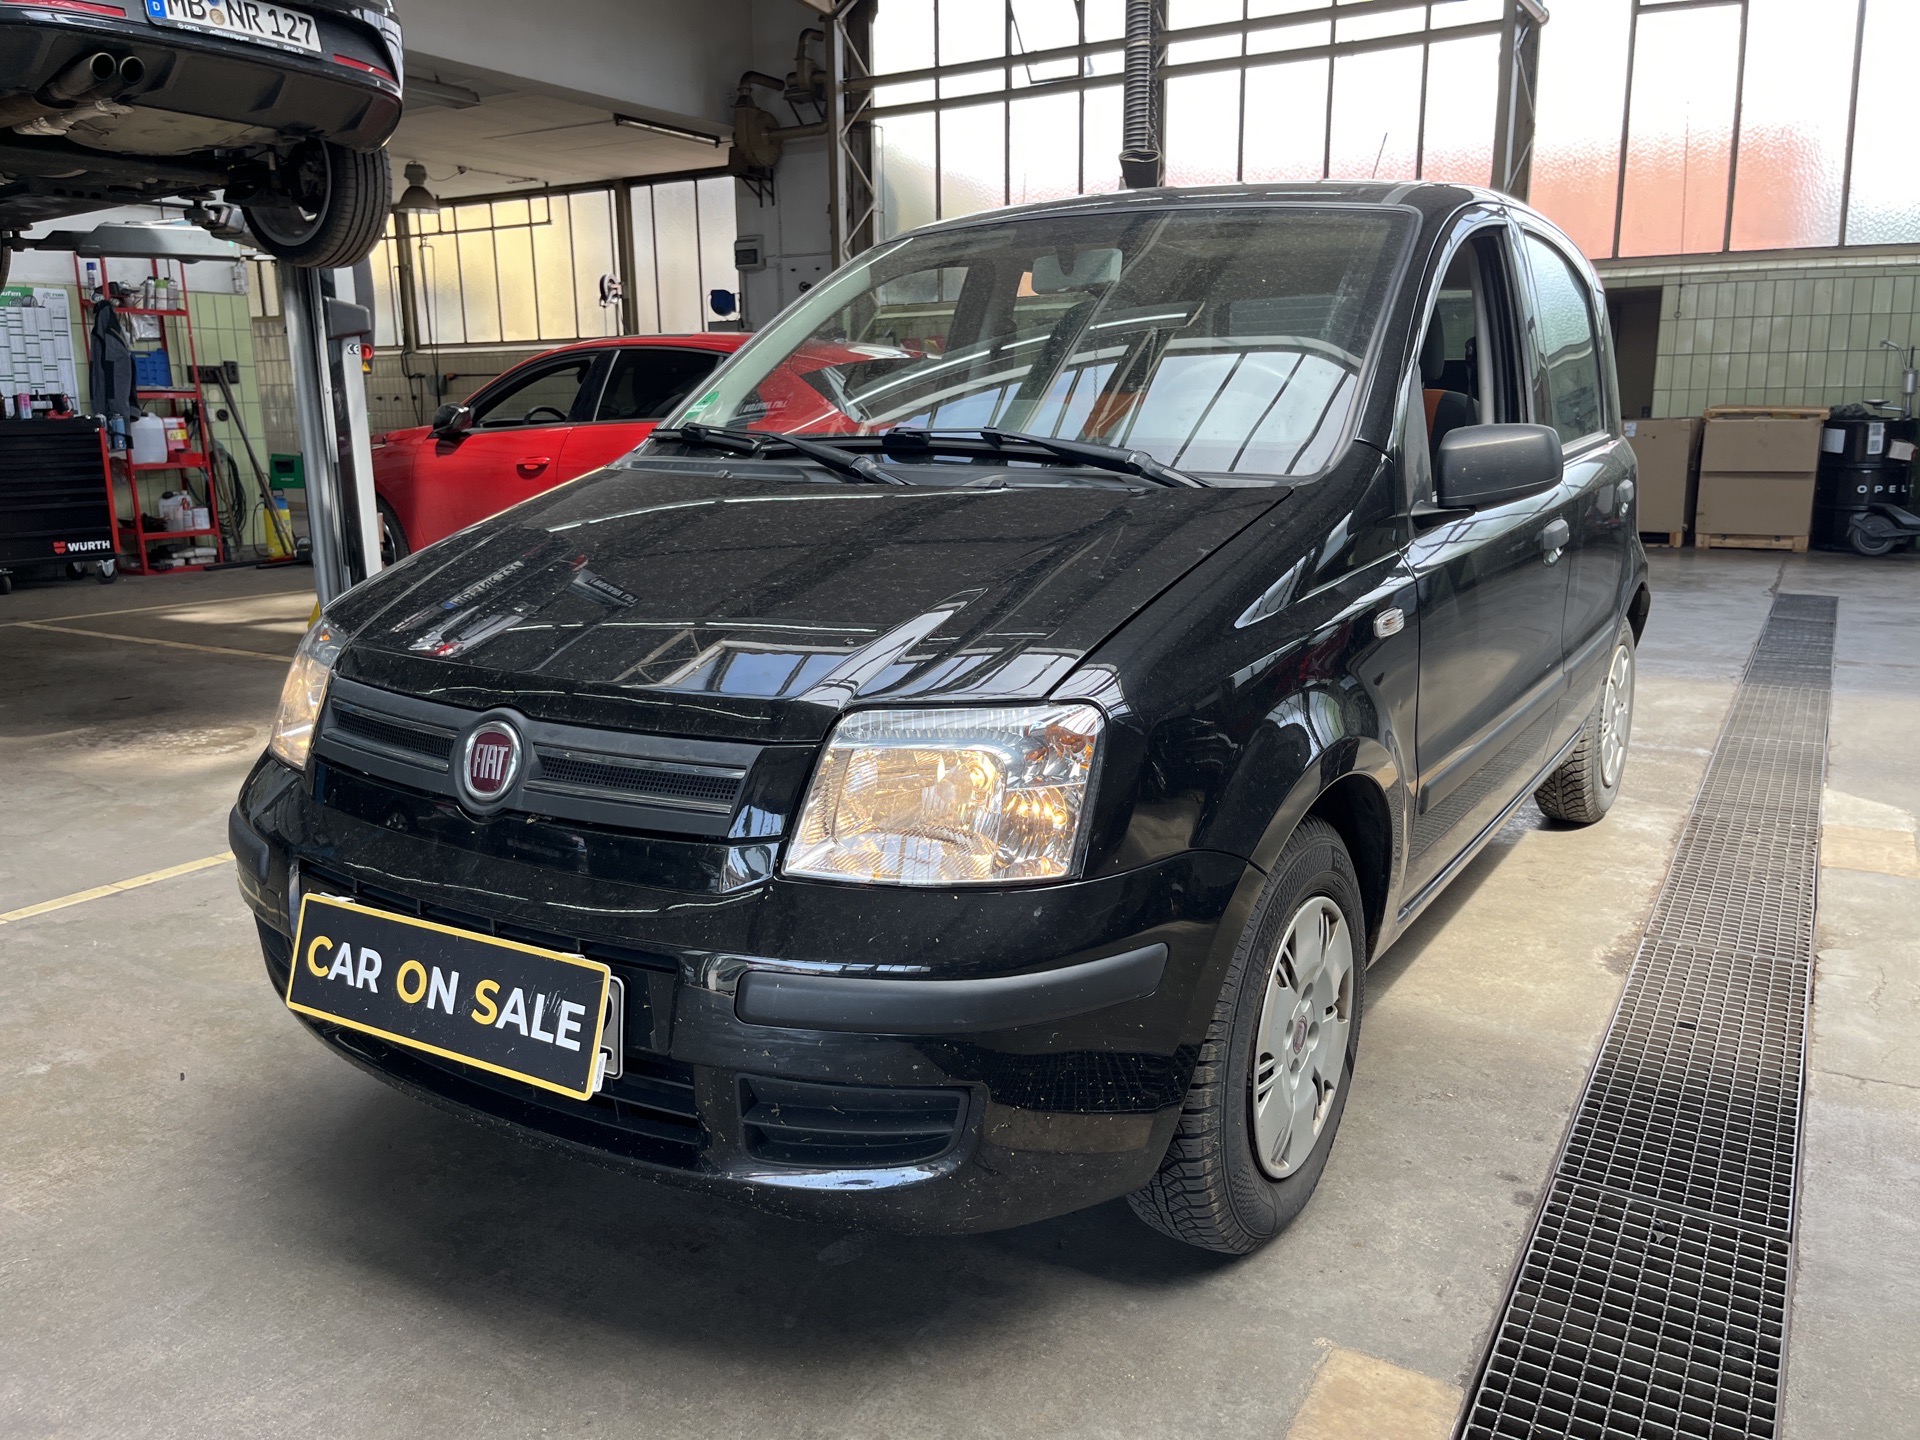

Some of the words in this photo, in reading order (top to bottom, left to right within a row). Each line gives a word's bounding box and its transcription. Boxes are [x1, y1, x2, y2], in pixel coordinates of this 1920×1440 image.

[152, 1, 161, 11] D
[167, 0, 207, 20] MB
[224, 0, 264, 33] NR
[267, 8, 314, 45] 127
[1856, 484, 1907, 494] OPEL
[472, 743, 509, 781] FIAT
[307, 935, 382, 994] CAR
[396, 959, 459, 1015] ON
[471, 979, 586, 1052] SALE
[1246, 947, 1266, 1007] GRIP
